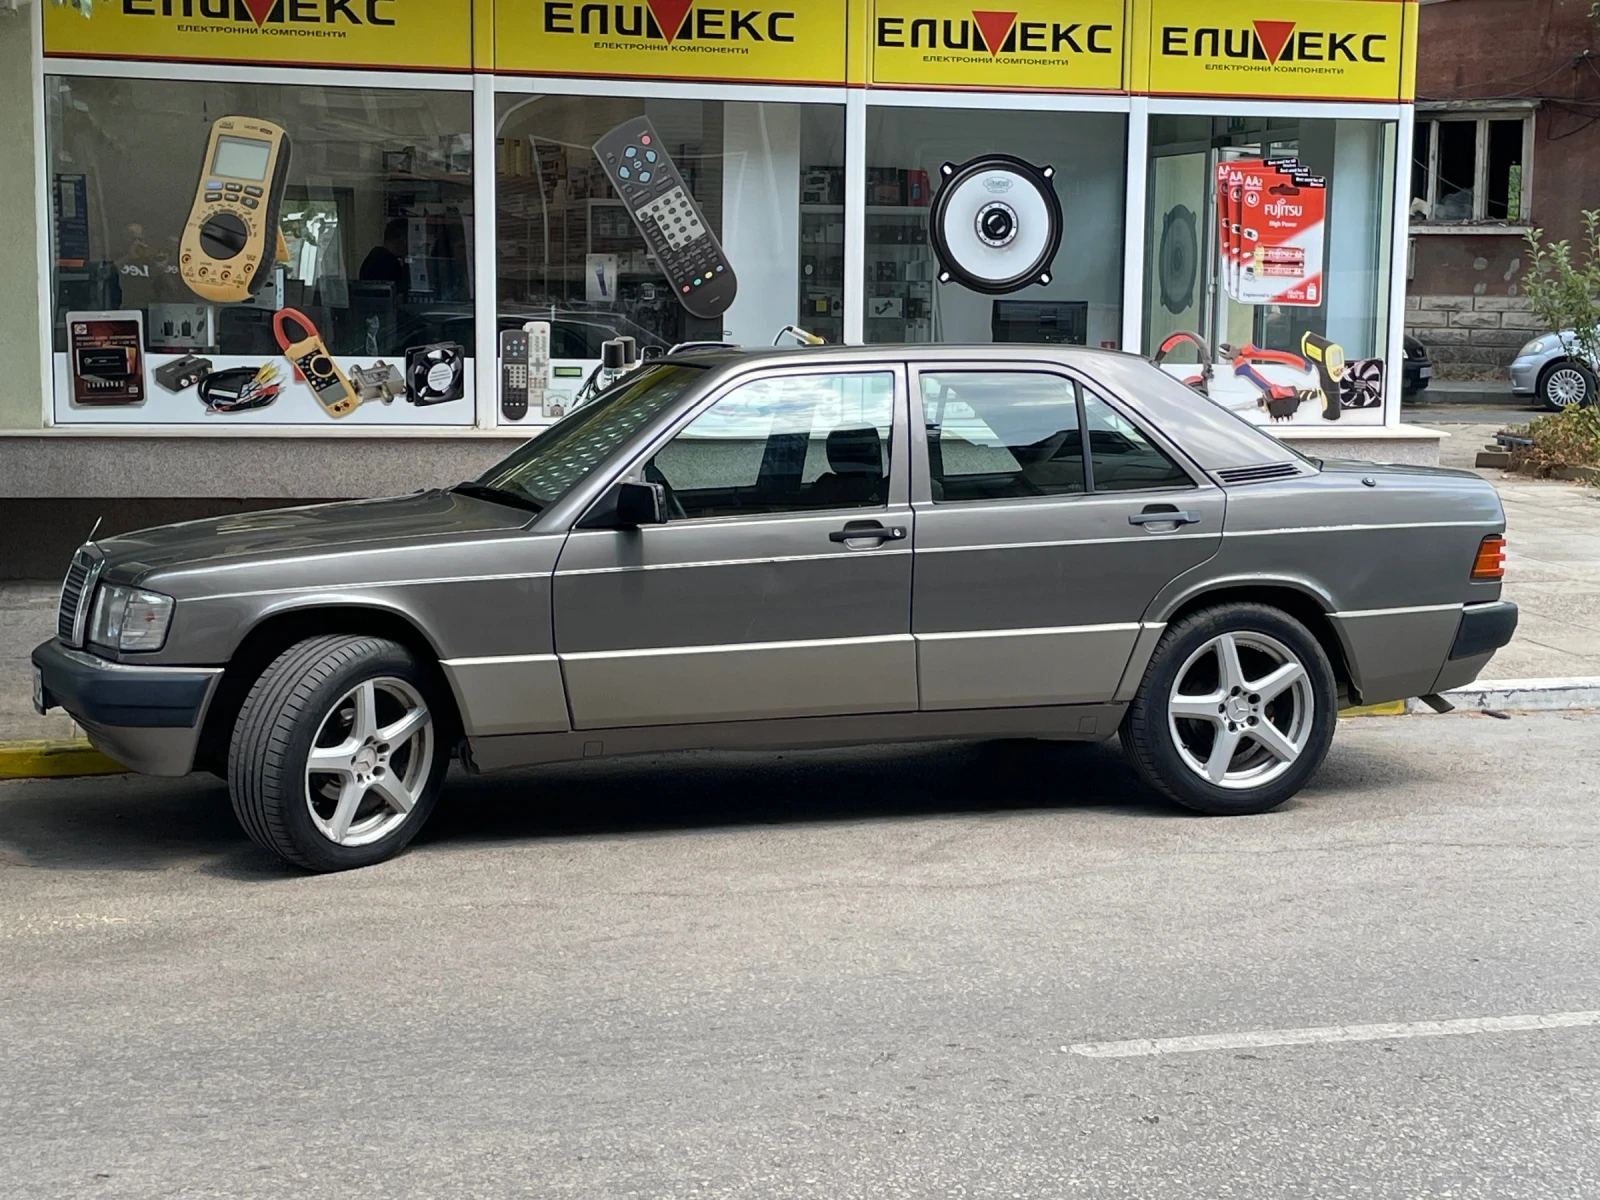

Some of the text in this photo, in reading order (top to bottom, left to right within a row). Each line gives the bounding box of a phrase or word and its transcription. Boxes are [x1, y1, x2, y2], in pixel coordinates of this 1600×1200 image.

[177, 24, 347, 39] ЕЛЕКТРОННИ КОМПОНЕНТИ
[593, 41, 749, 55] ЕЛЕКТРОННИ КОМПОНЕНТИ
[922, 55, 1069, 66] ЕЛЕКТРОННИ КОМПОНЕНТИ
[1205, 63, 1344, 75] ЕЛЕКТРОННИ КОМПОНЕНТИ
[1264, 198, 1303, 218] FUJITSU
